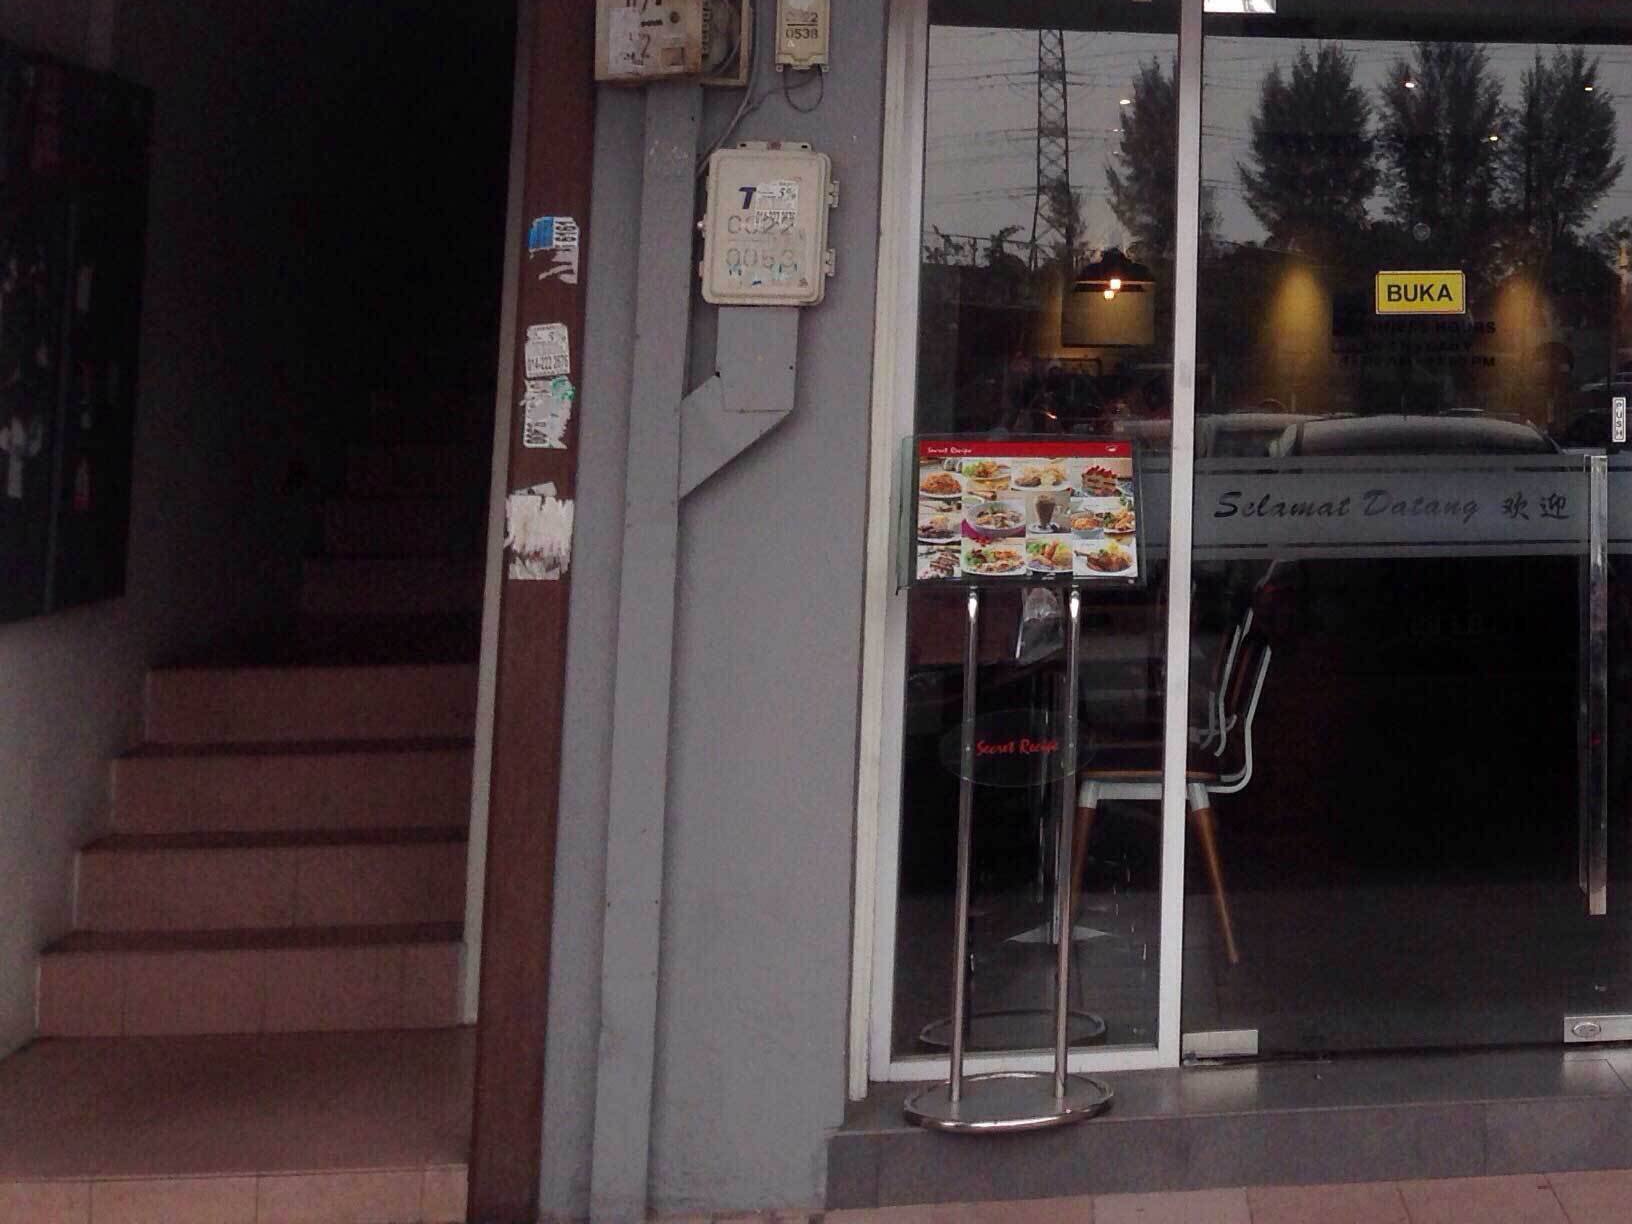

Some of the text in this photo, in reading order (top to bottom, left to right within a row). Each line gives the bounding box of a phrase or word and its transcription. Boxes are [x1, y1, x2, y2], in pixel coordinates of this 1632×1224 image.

[786, 28, 818, 40] 0538
[1387, 283, 1453, 302] BUKA
[1614, 401, 1623, 437] PUSH
[1214, 489, 1479, 525] Selamat Datang
